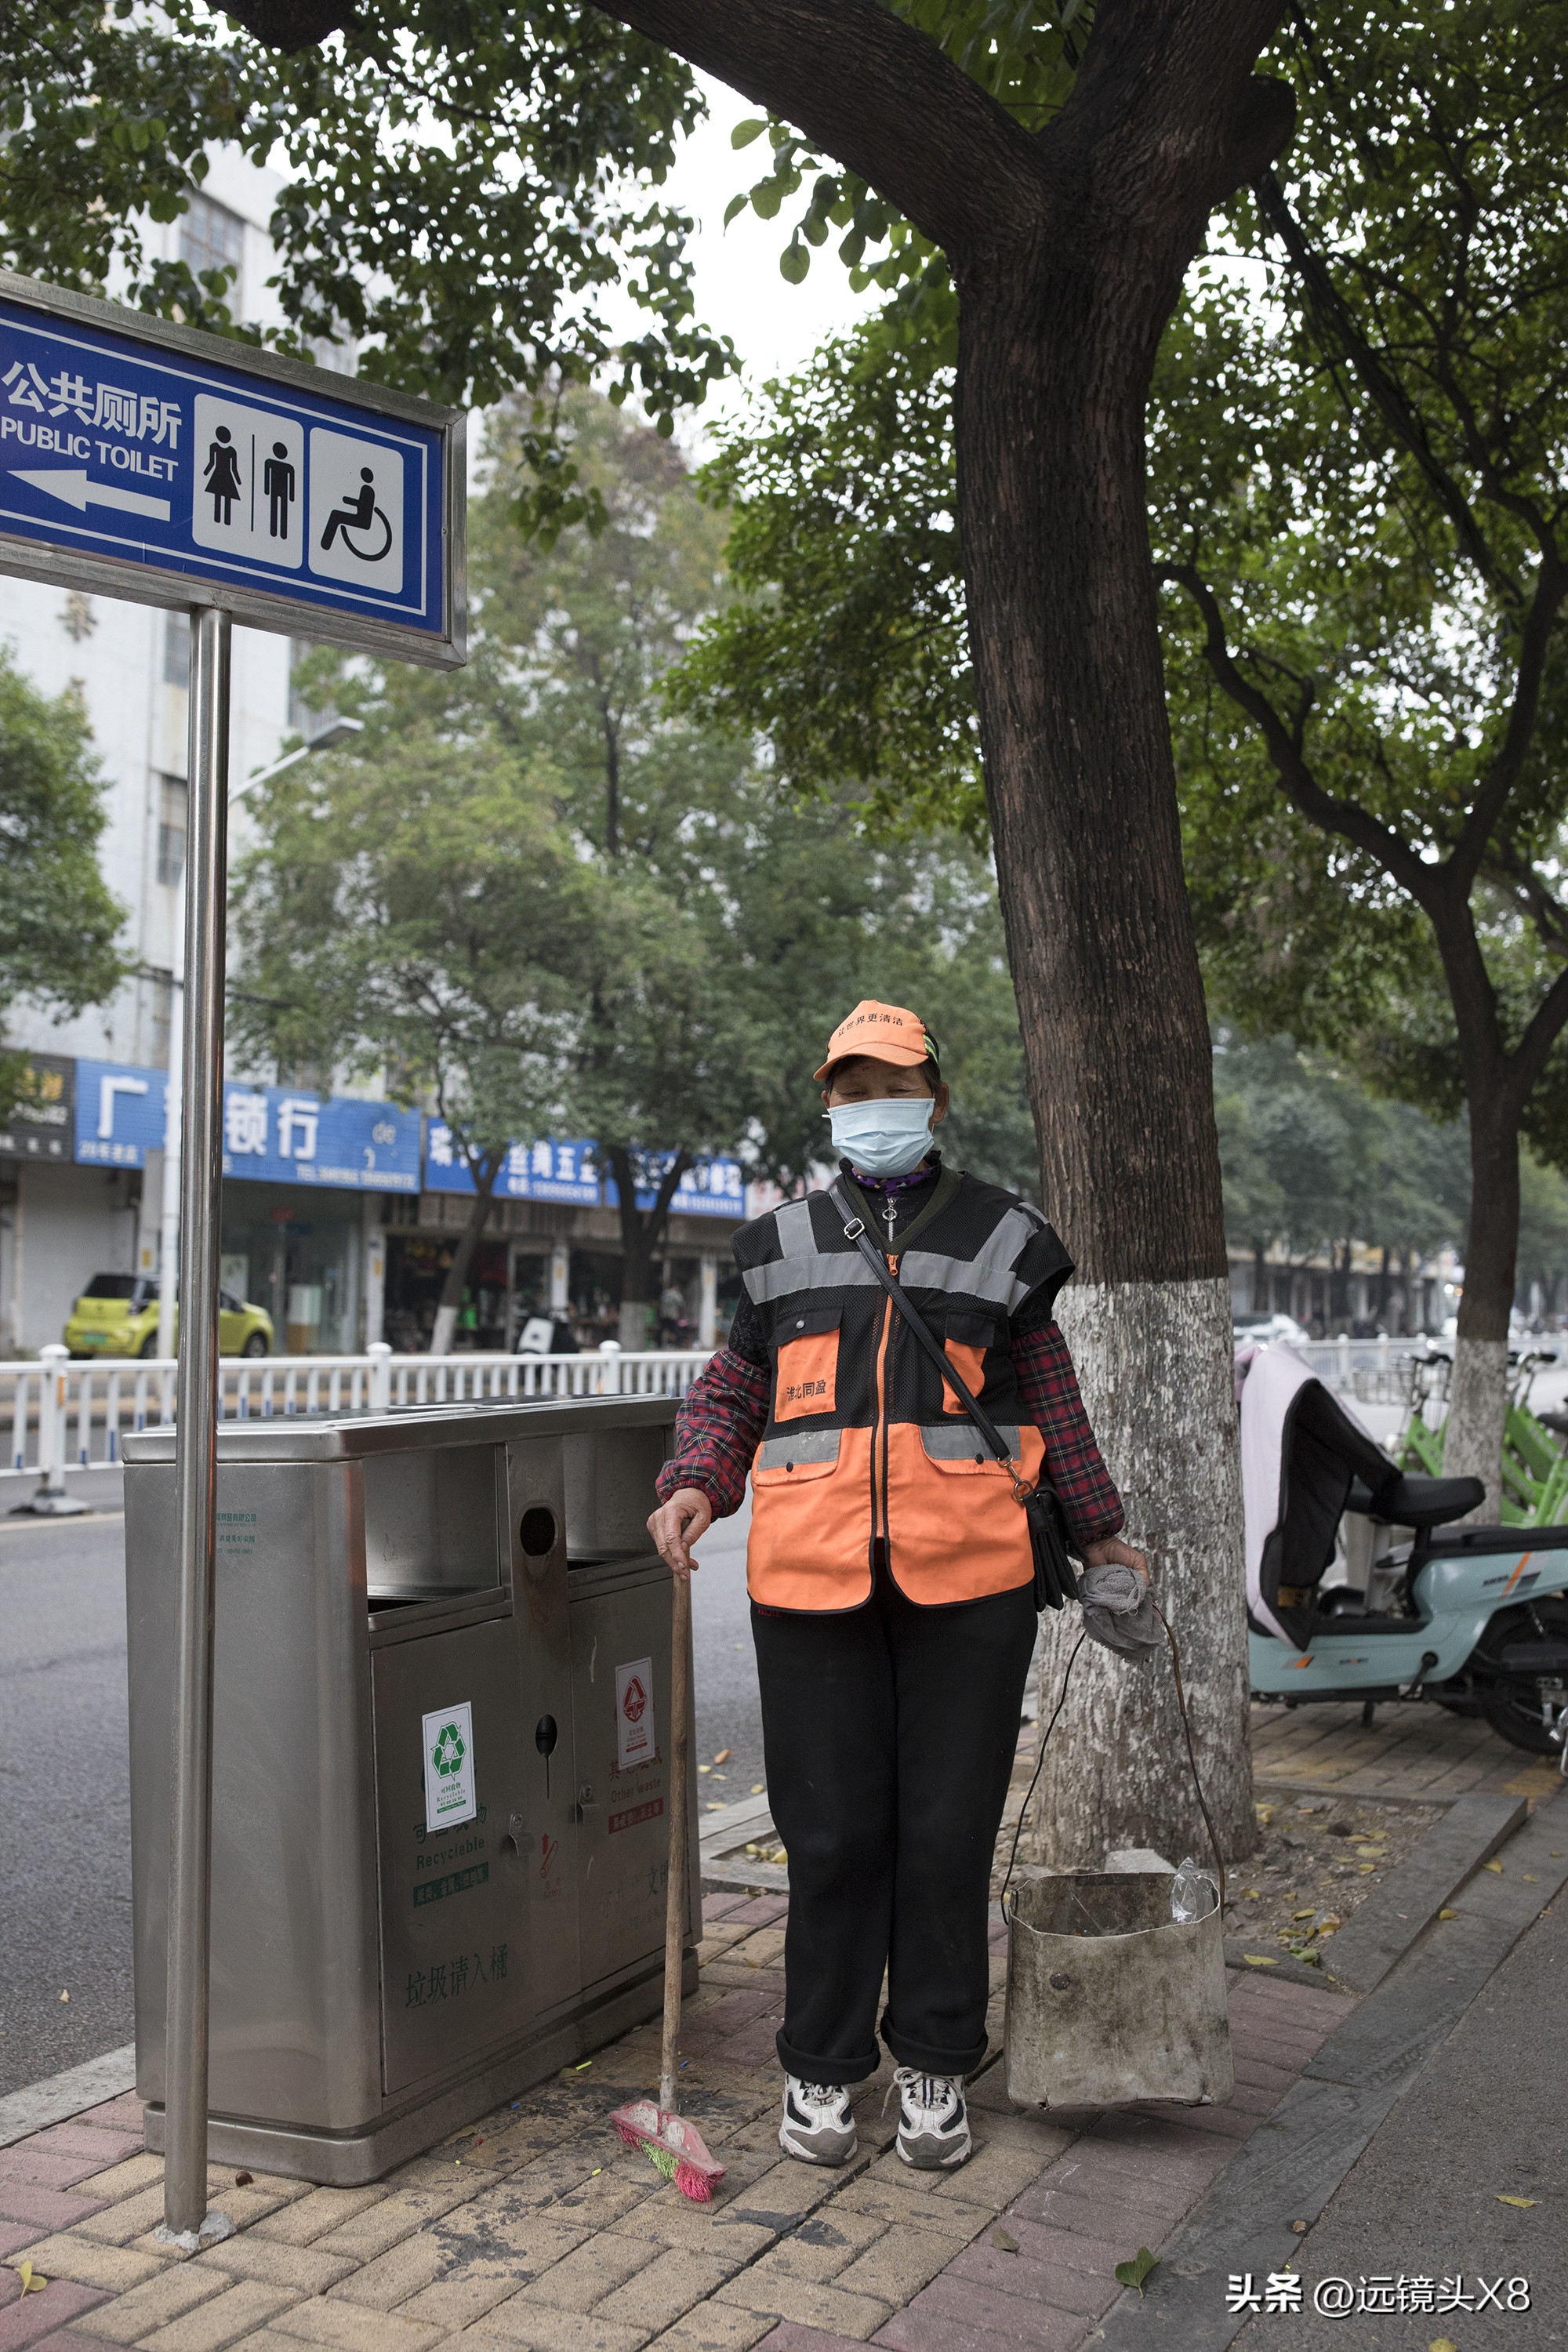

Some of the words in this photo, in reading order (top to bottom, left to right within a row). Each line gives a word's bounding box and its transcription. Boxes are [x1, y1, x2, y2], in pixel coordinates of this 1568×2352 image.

[1, 361, 182, 449] 公共厕所
[1, 416, 91, 459] PUBLIC
[95, 441, 179, 481] TOILET
[838, 1013, 903, 1037] 让世界更清洁
[786, 1380, 826, 1401] 淮北同盈
[436, 1789, 466, 1802] Recyclable
[441, 1782, 460, 1793] 可回收物
[611, 1788, 634, 1803] Other
[637, 1777, 661, 1794] waste
[416, 1836, 485, 1871] Recyclable
[405, 1943, 507, 2009] 垃圾请入桶
